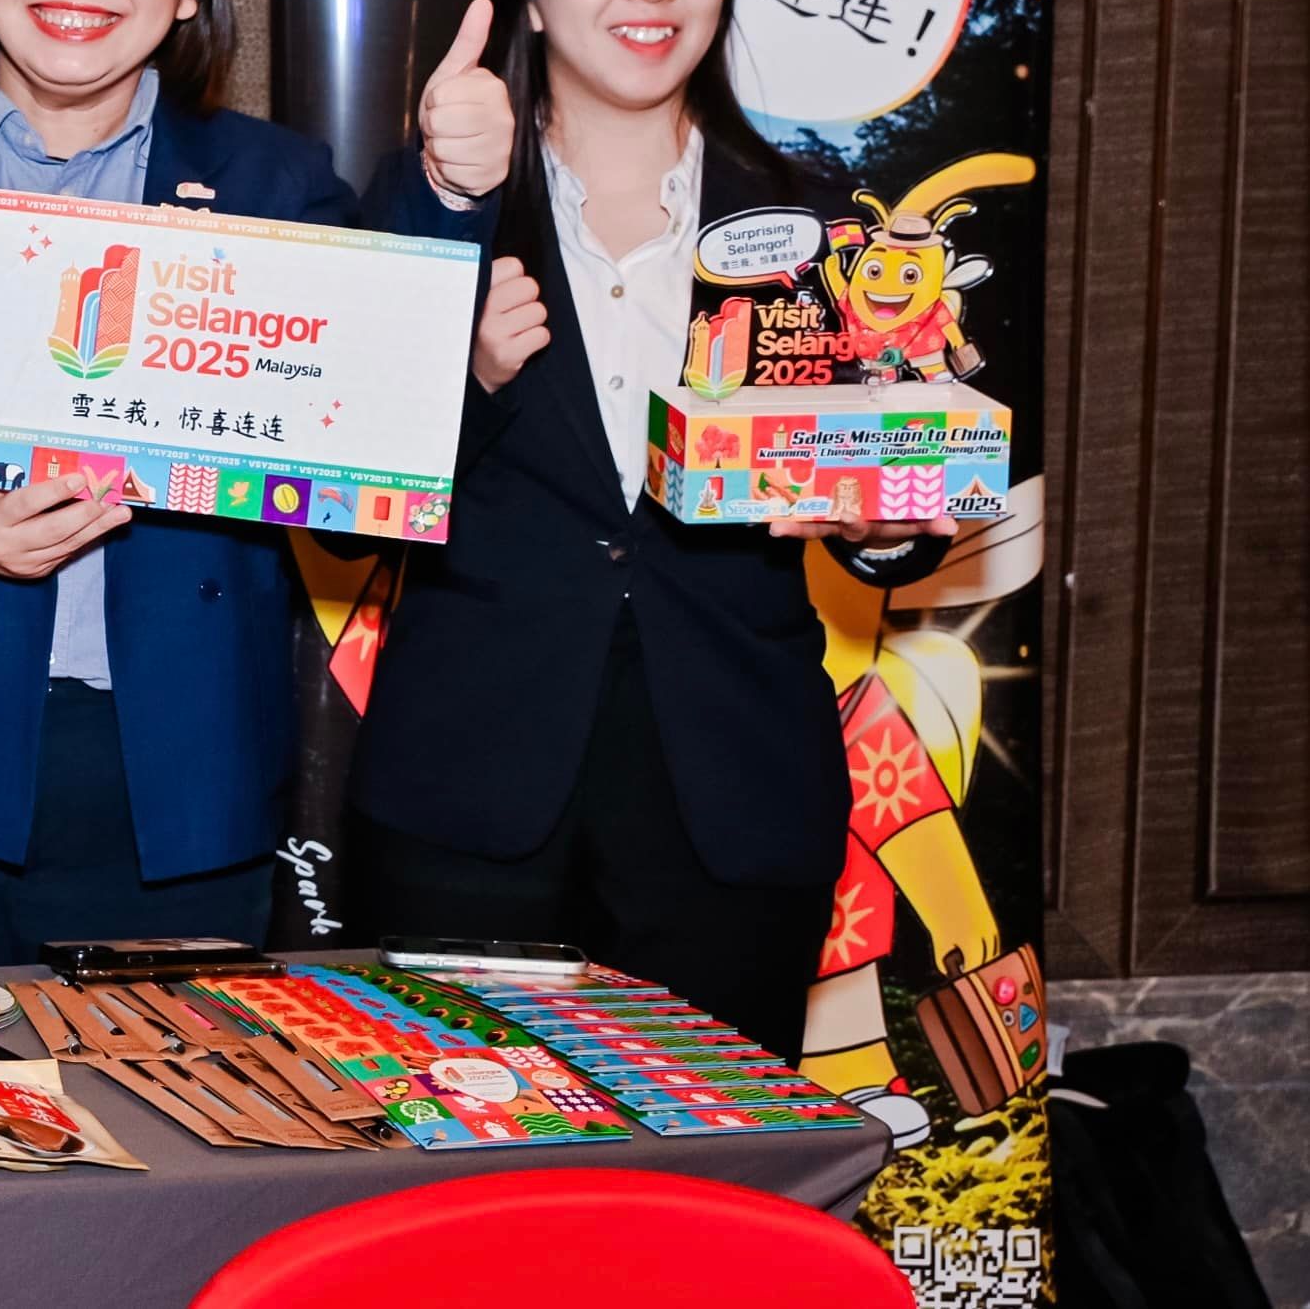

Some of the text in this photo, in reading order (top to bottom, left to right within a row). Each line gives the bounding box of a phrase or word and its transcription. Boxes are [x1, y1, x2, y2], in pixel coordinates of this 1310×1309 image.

[26, 201, 68, 212] VSY2025
[724, 223, 794, 241] Surprising
[727, 236, 793, 256] Selangor!
[152, 256, 237, 295] visit
[146, 293, 328, 346] Selangor
[757, 299, 820, 329] visit
[141, 334, 322, 381] 2025 Malaysia
[756, 330, 857, 362] Selang
[754, 360, 833, 386] 2025
[792, 426, 1003, 446] Sales Mission to China
[147, 447, 190, 460] VSY2025
[197, 453, 240, 466] VSY2025
[248, 459, 291, 472] VSY2025
[299, 466, 342, 478] VSY2025
[350, 472, 393, 484] VSY2025
[758, 445, 1002, 459] Kunming Chengdu Qingdao Zhengzhou
[947, 496, 1003, 513] 2025
[276, 836, 343, 937] Spark
